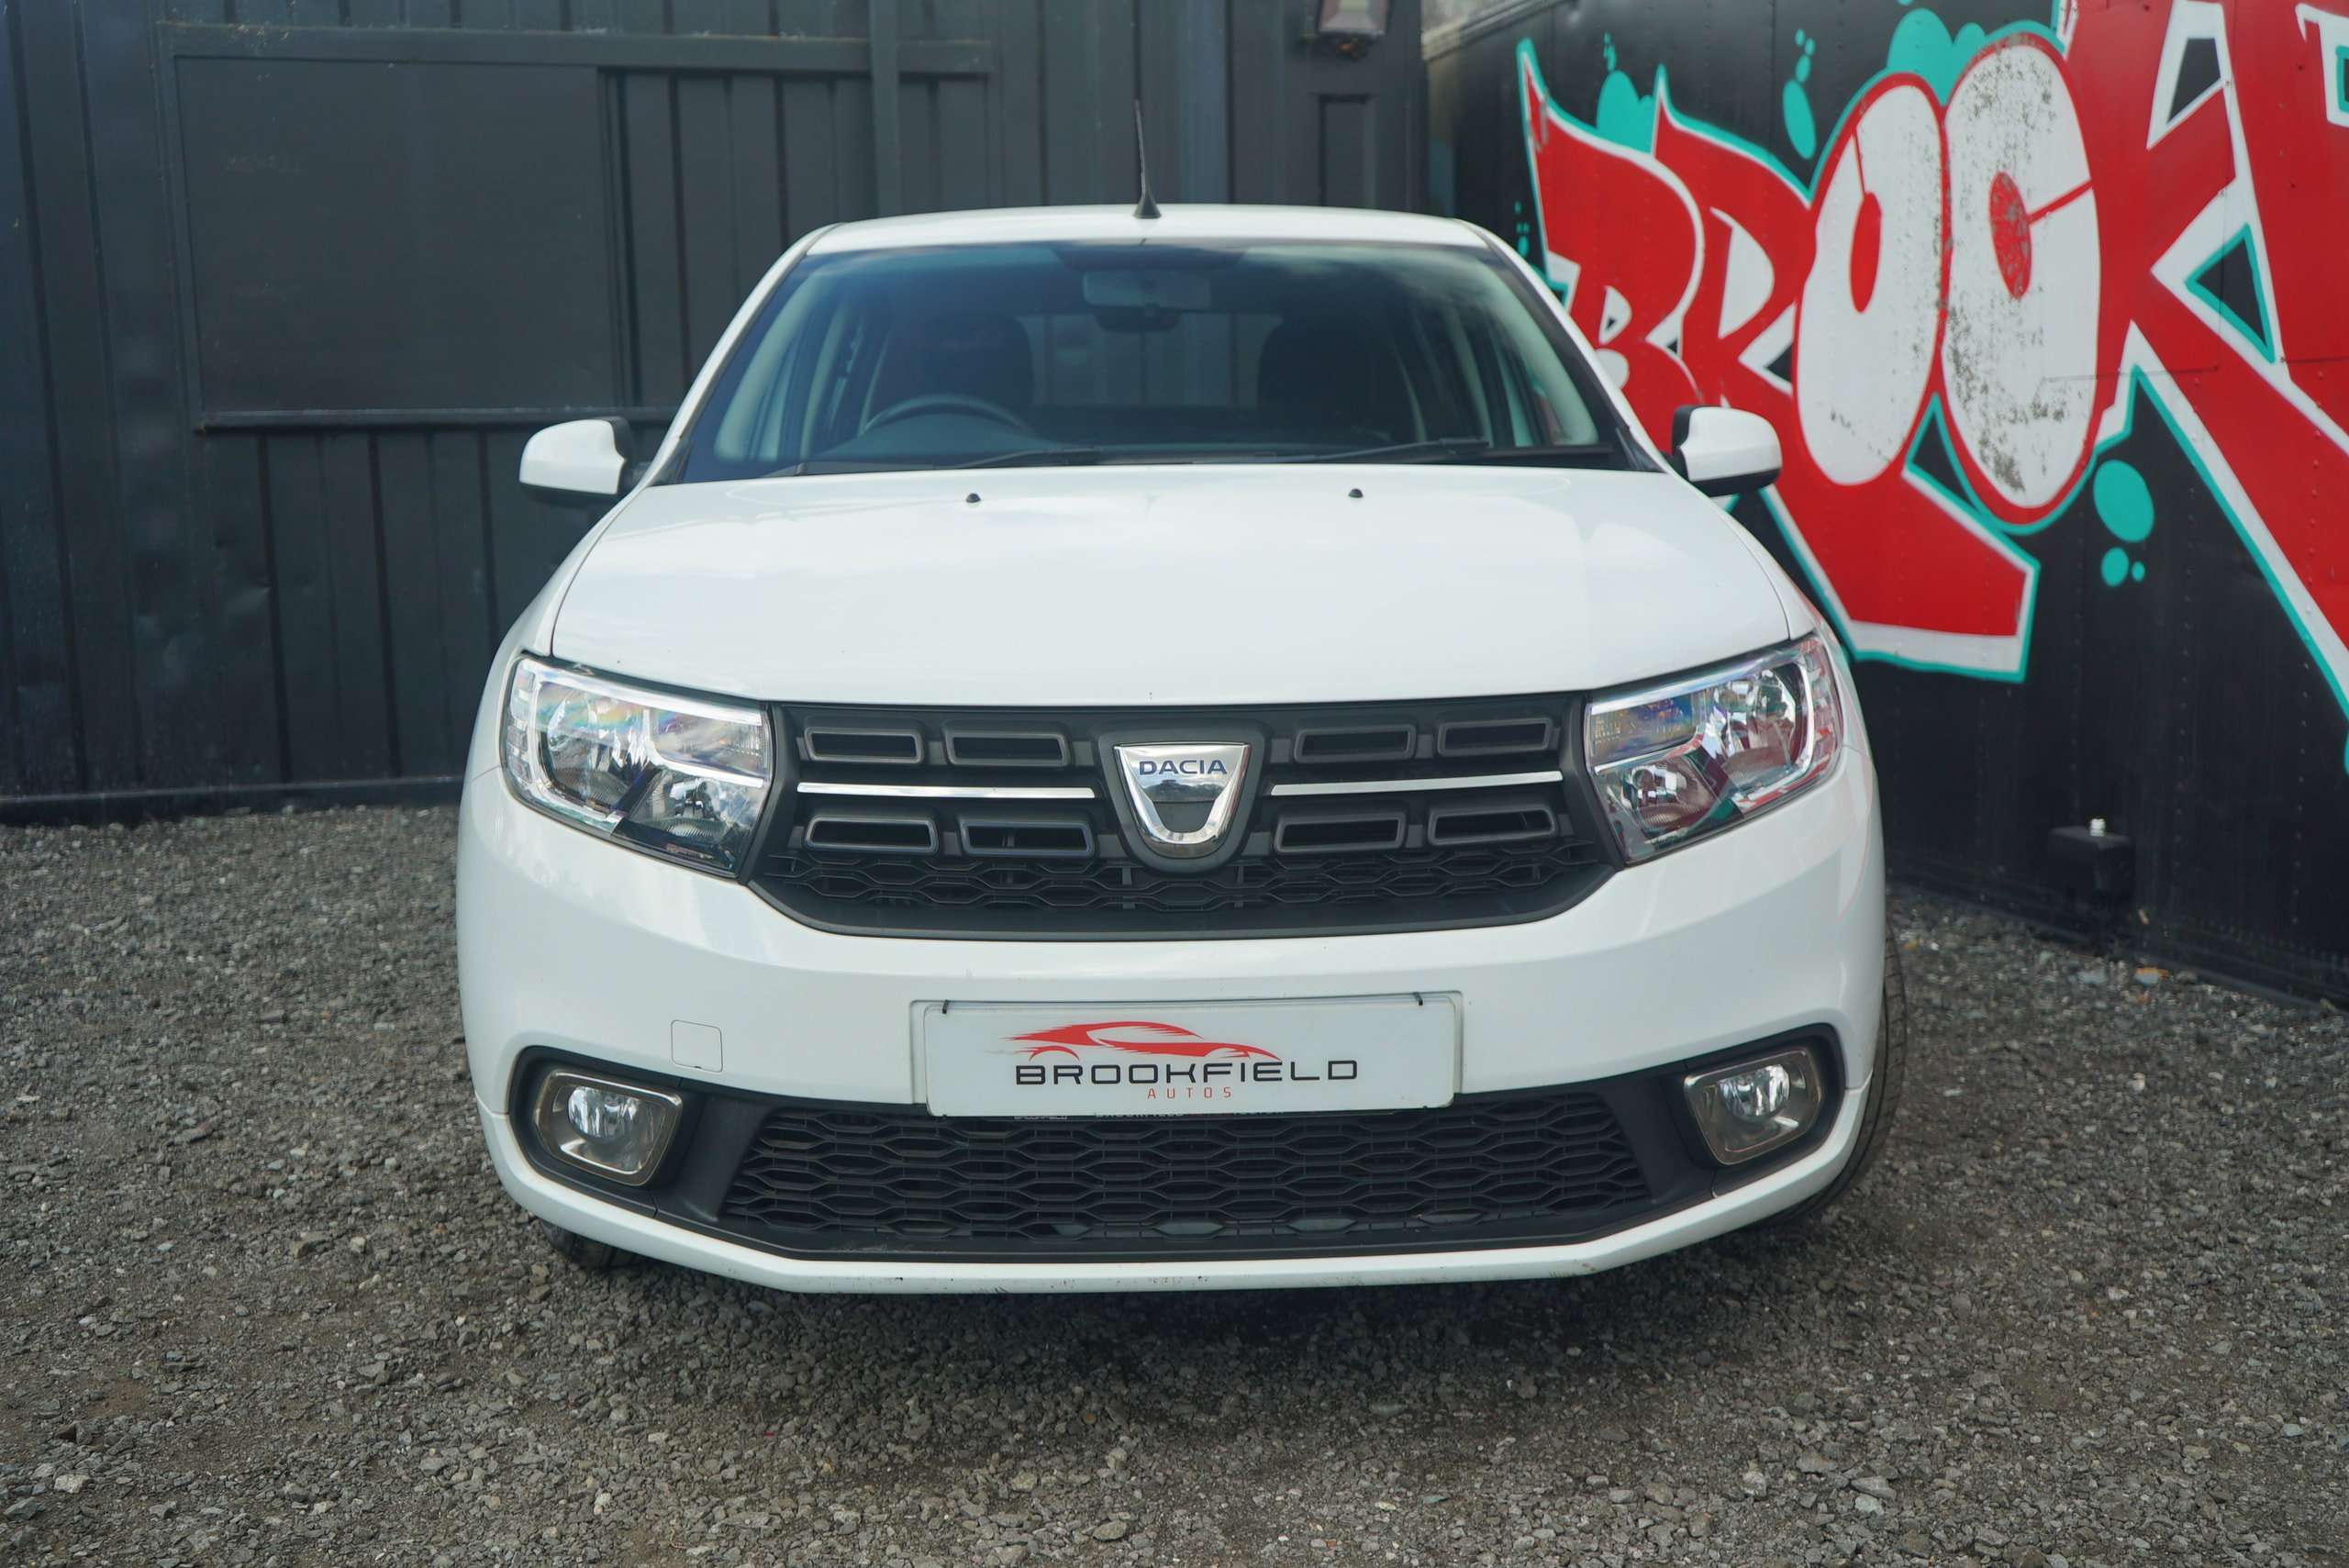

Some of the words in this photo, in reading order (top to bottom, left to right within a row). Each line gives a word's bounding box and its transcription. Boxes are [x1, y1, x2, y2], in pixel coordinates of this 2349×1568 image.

[1138, 759, 1228, 776] DACIA
[1015, 1059, 1358, 1086] BROOKFIELD
[1146, 1086, 1232, 1100] AUTOS
